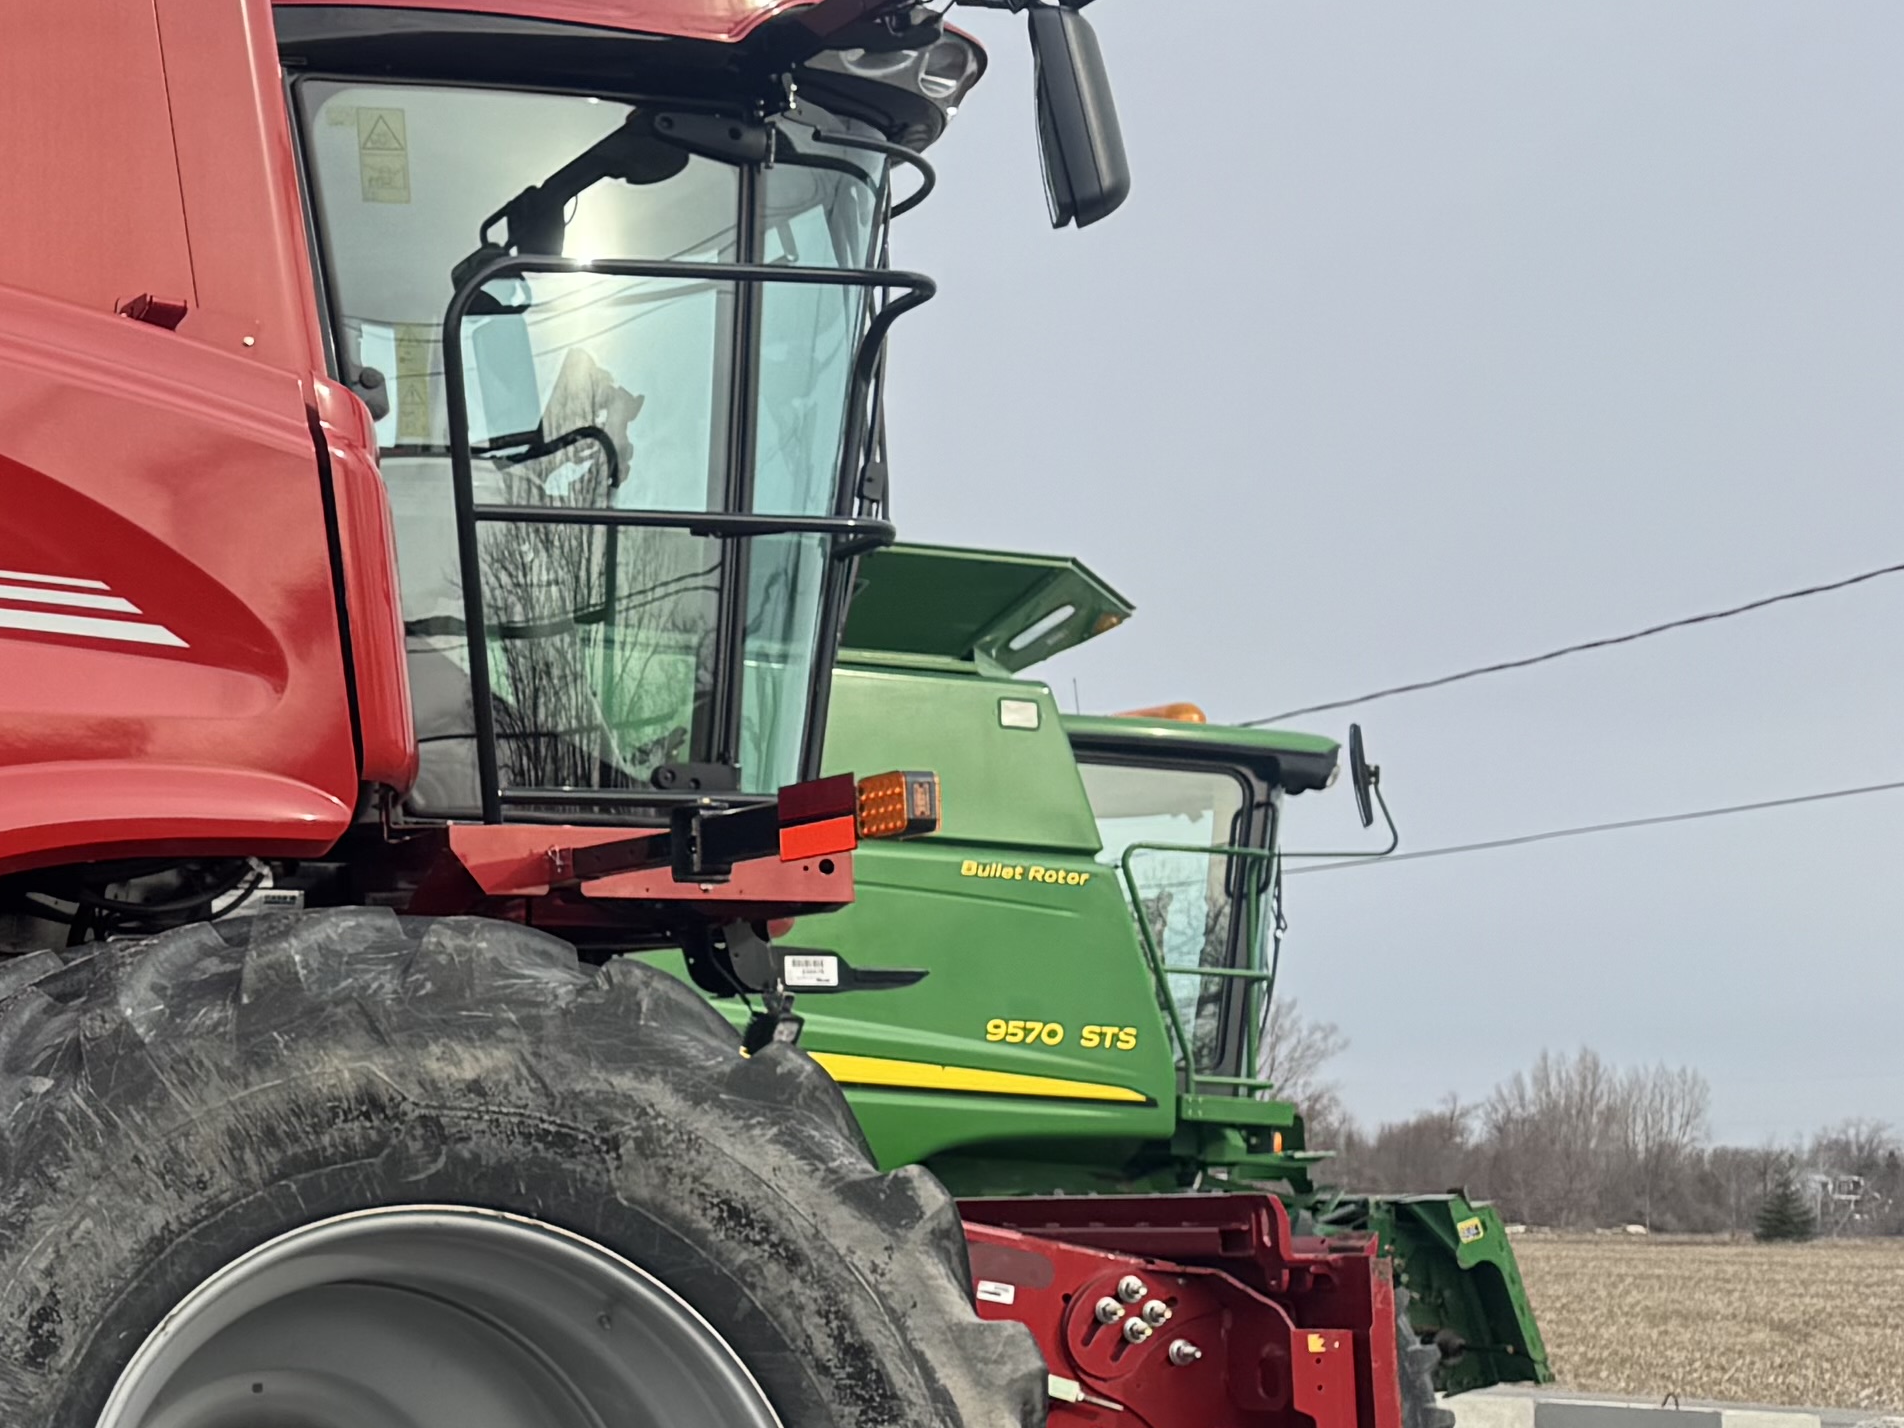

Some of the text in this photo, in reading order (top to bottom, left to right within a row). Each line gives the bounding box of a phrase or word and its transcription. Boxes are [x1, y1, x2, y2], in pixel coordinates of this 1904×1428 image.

[961, 860, 1089, 886] Bullet Rotor
[986, 1018, 1137, 1050] 9570 STS
